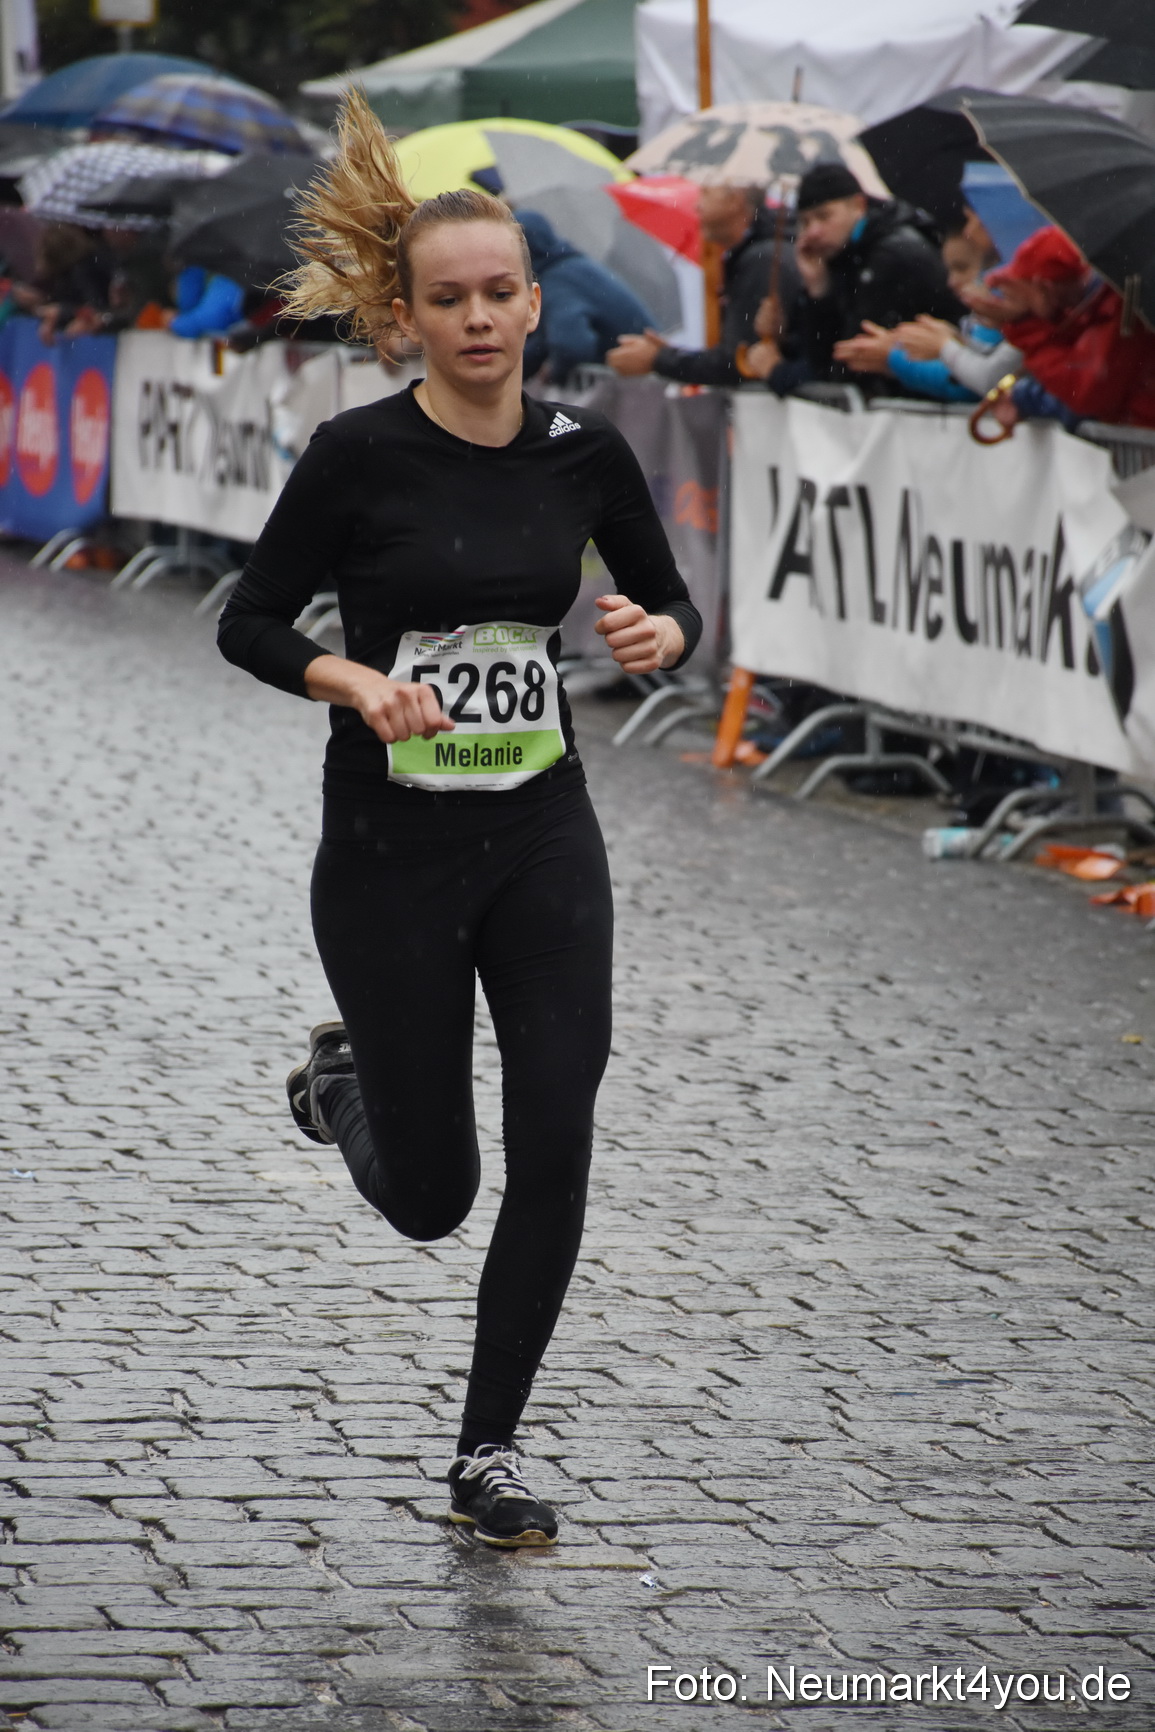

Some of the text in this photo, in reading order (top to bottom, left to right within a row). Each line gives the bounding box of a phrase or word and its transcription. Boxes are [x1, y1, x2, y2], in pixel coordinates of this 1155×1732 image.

[548, 422, 581, 438] adidas
[473, 625, 540, 646] BOCK
[410, 659, 546, 724] 5268
[435, 741, 523, 768] Melanie
